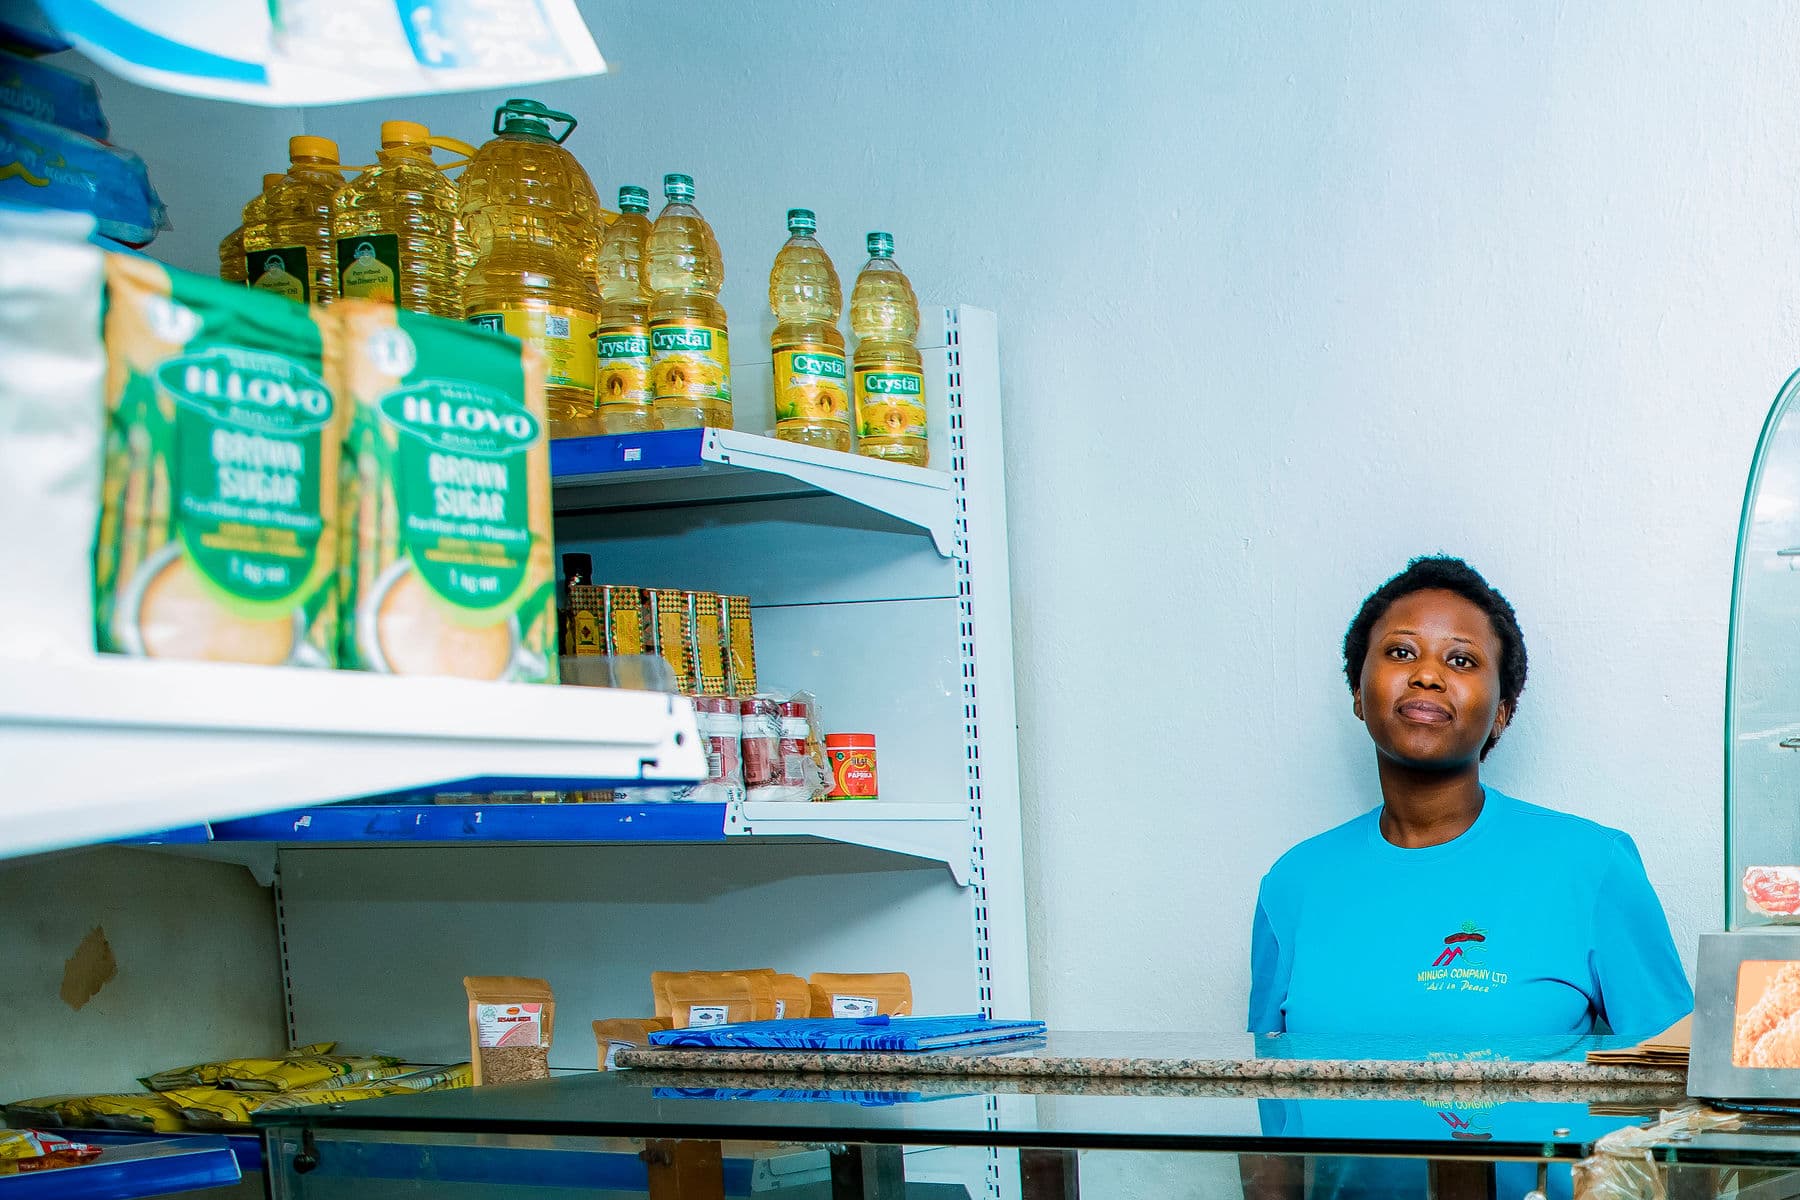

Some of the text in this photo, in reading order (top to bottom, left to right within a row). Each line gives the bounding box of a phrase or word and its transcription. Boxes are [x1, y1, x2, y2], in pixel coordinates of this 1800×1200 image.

[652, 330, 709, 349] Crystal
[185, 366, 328, 415] ILLOVO
[866, 376, 920, 393] Crystal
[403, 396, 532, 439] ILLOVO
[429, 453, 508, 490] BROWN
[434, 487, 505, 521] SUGAR
[1417, 968, 1508, 984] MINUGA COMPANY LTD
